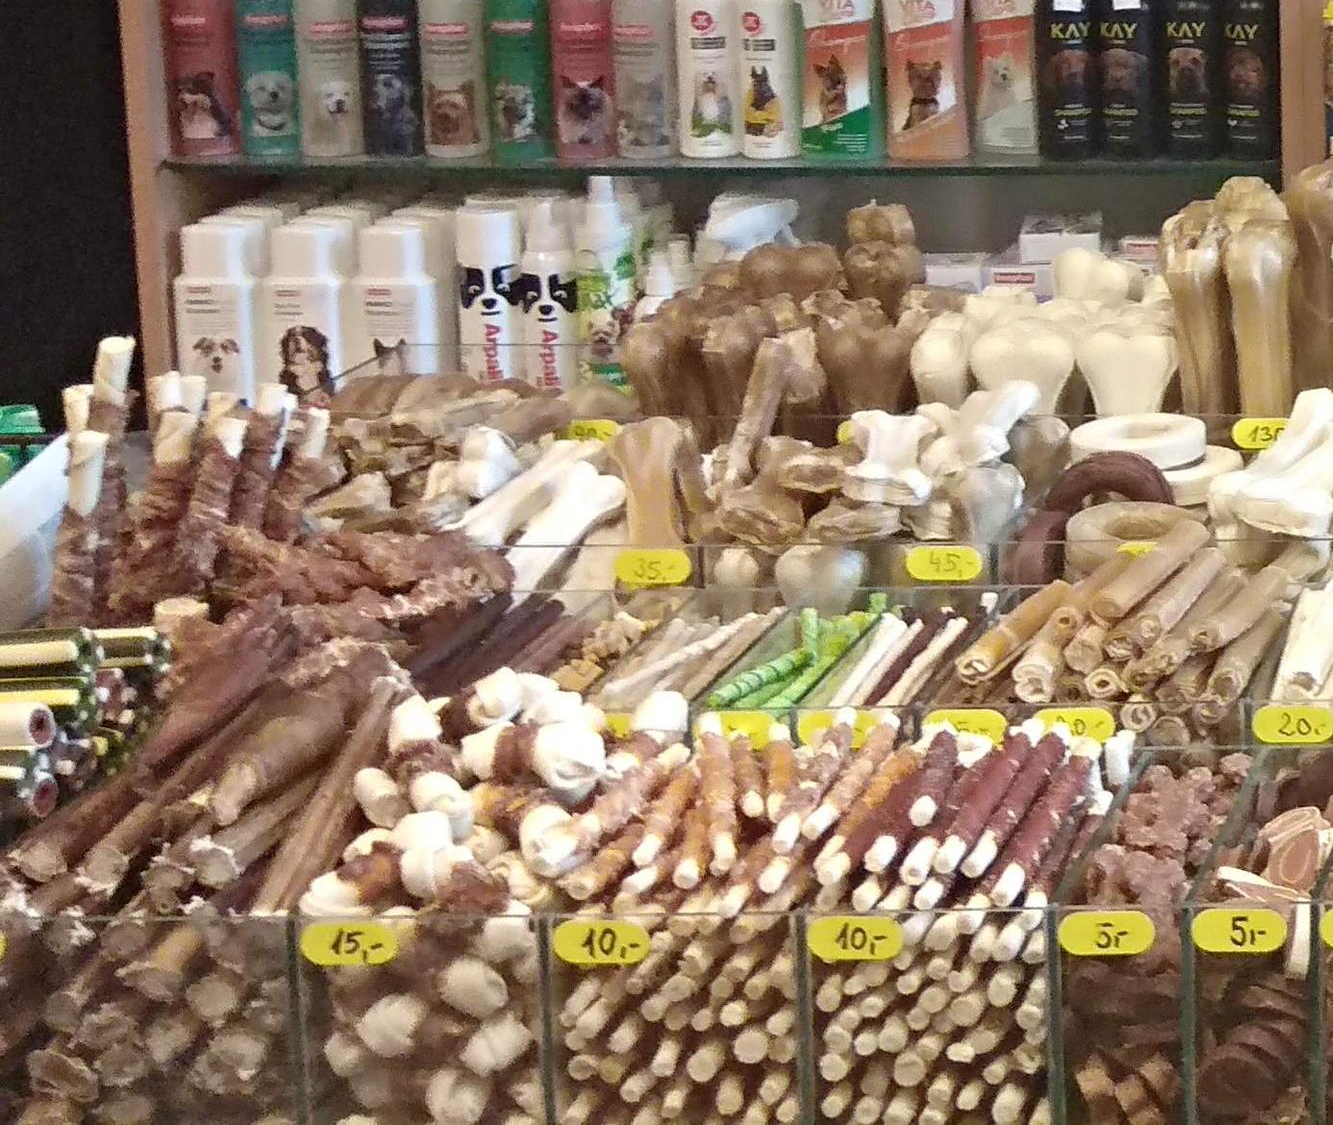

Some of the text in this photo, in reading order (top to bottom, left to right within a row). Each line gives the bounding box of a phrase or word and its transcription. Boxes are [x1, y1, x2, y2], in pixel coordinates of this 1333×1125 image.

[1050, 23, 1091, 40] KAY
[1101, 22, 1137, 39] KAY
[1166, 21, 1205, 39] KAY
